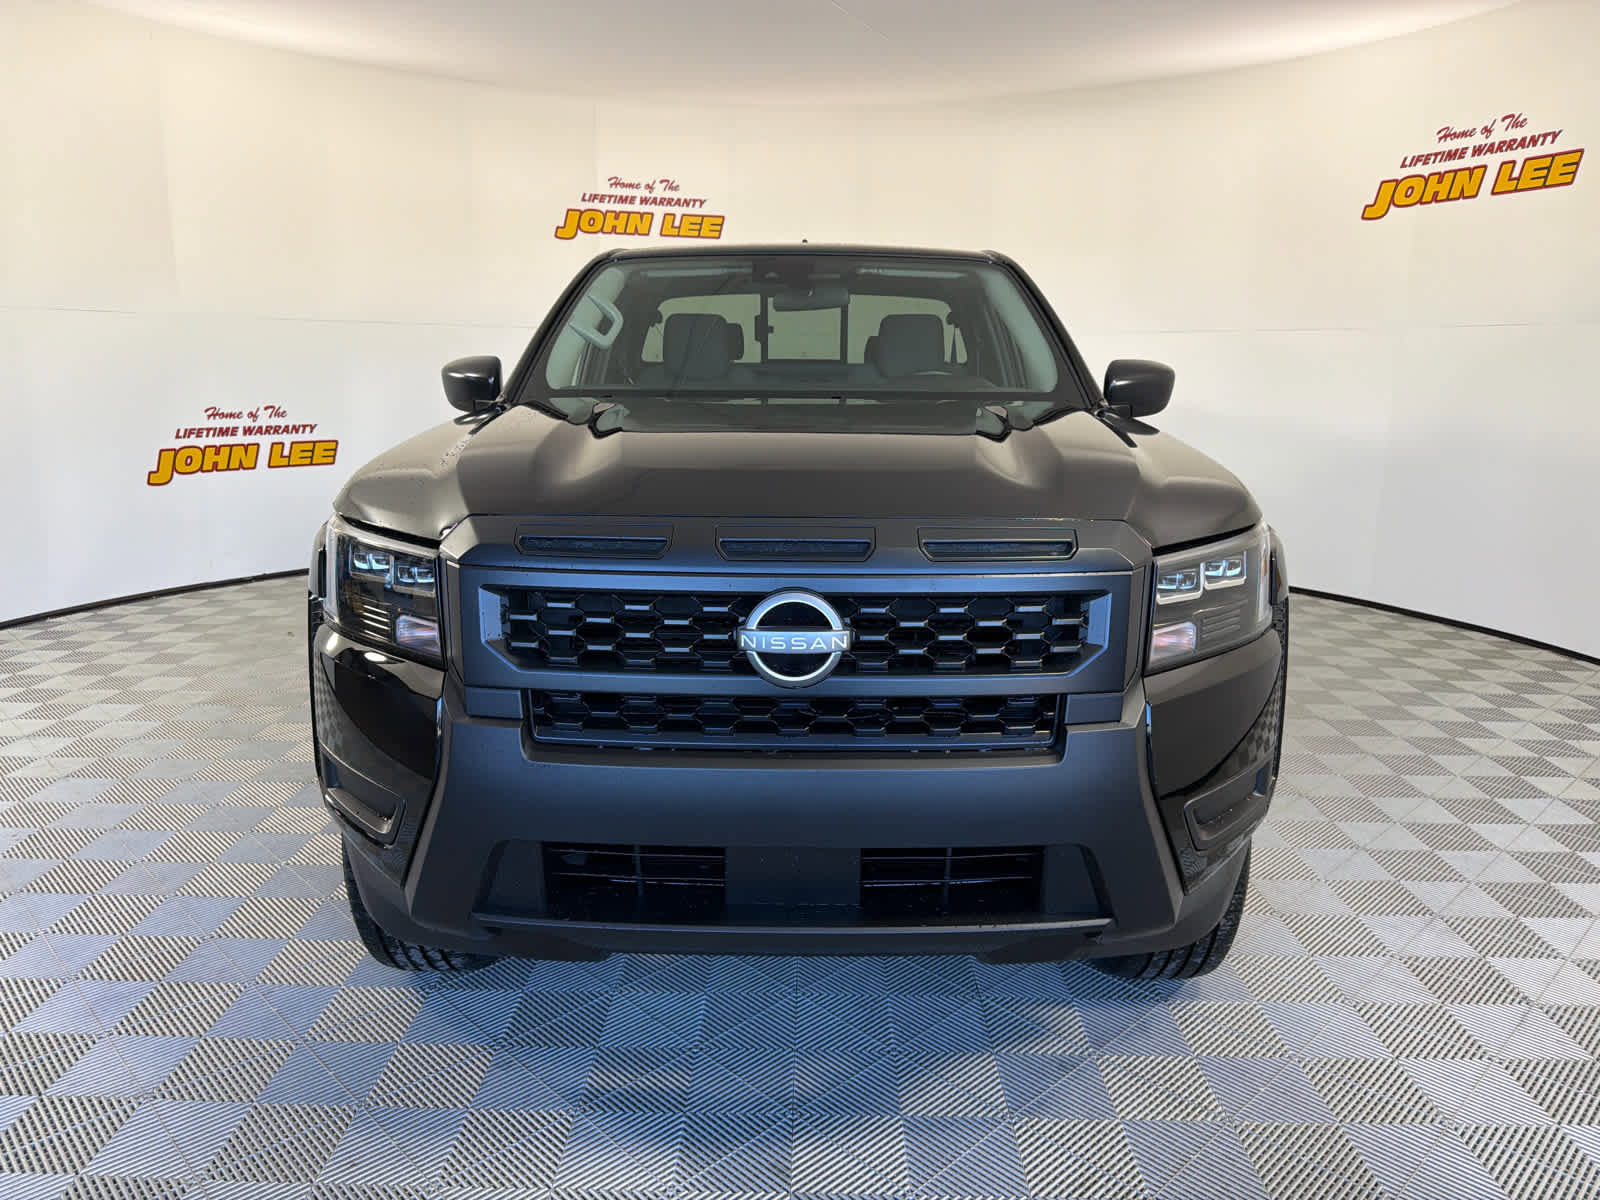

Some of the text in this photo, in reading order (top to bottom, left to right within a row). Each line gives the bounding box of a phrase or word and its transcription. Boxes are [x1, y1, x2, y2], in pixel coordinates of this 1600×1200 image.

[1436, 113, 1528, 143] Home of The
[1400, 129, 1563, 169] LIFETIME WARRANTY
[608, 176, 680, 194] Home of The
[1361, 148, 1585, 221] JOHN LEE
[581, 192, 706, 209] LIFETIME WARRANTY
[555, 208, 725, 240] JOHN LEE
[204, 405, 288, 422] Home of The
[175, 423, 317, 439] LIFETIME WARRANTY
[147, 440, 339, 486] JOHN LEE
[741, 634, 848, 650] NISSAN
